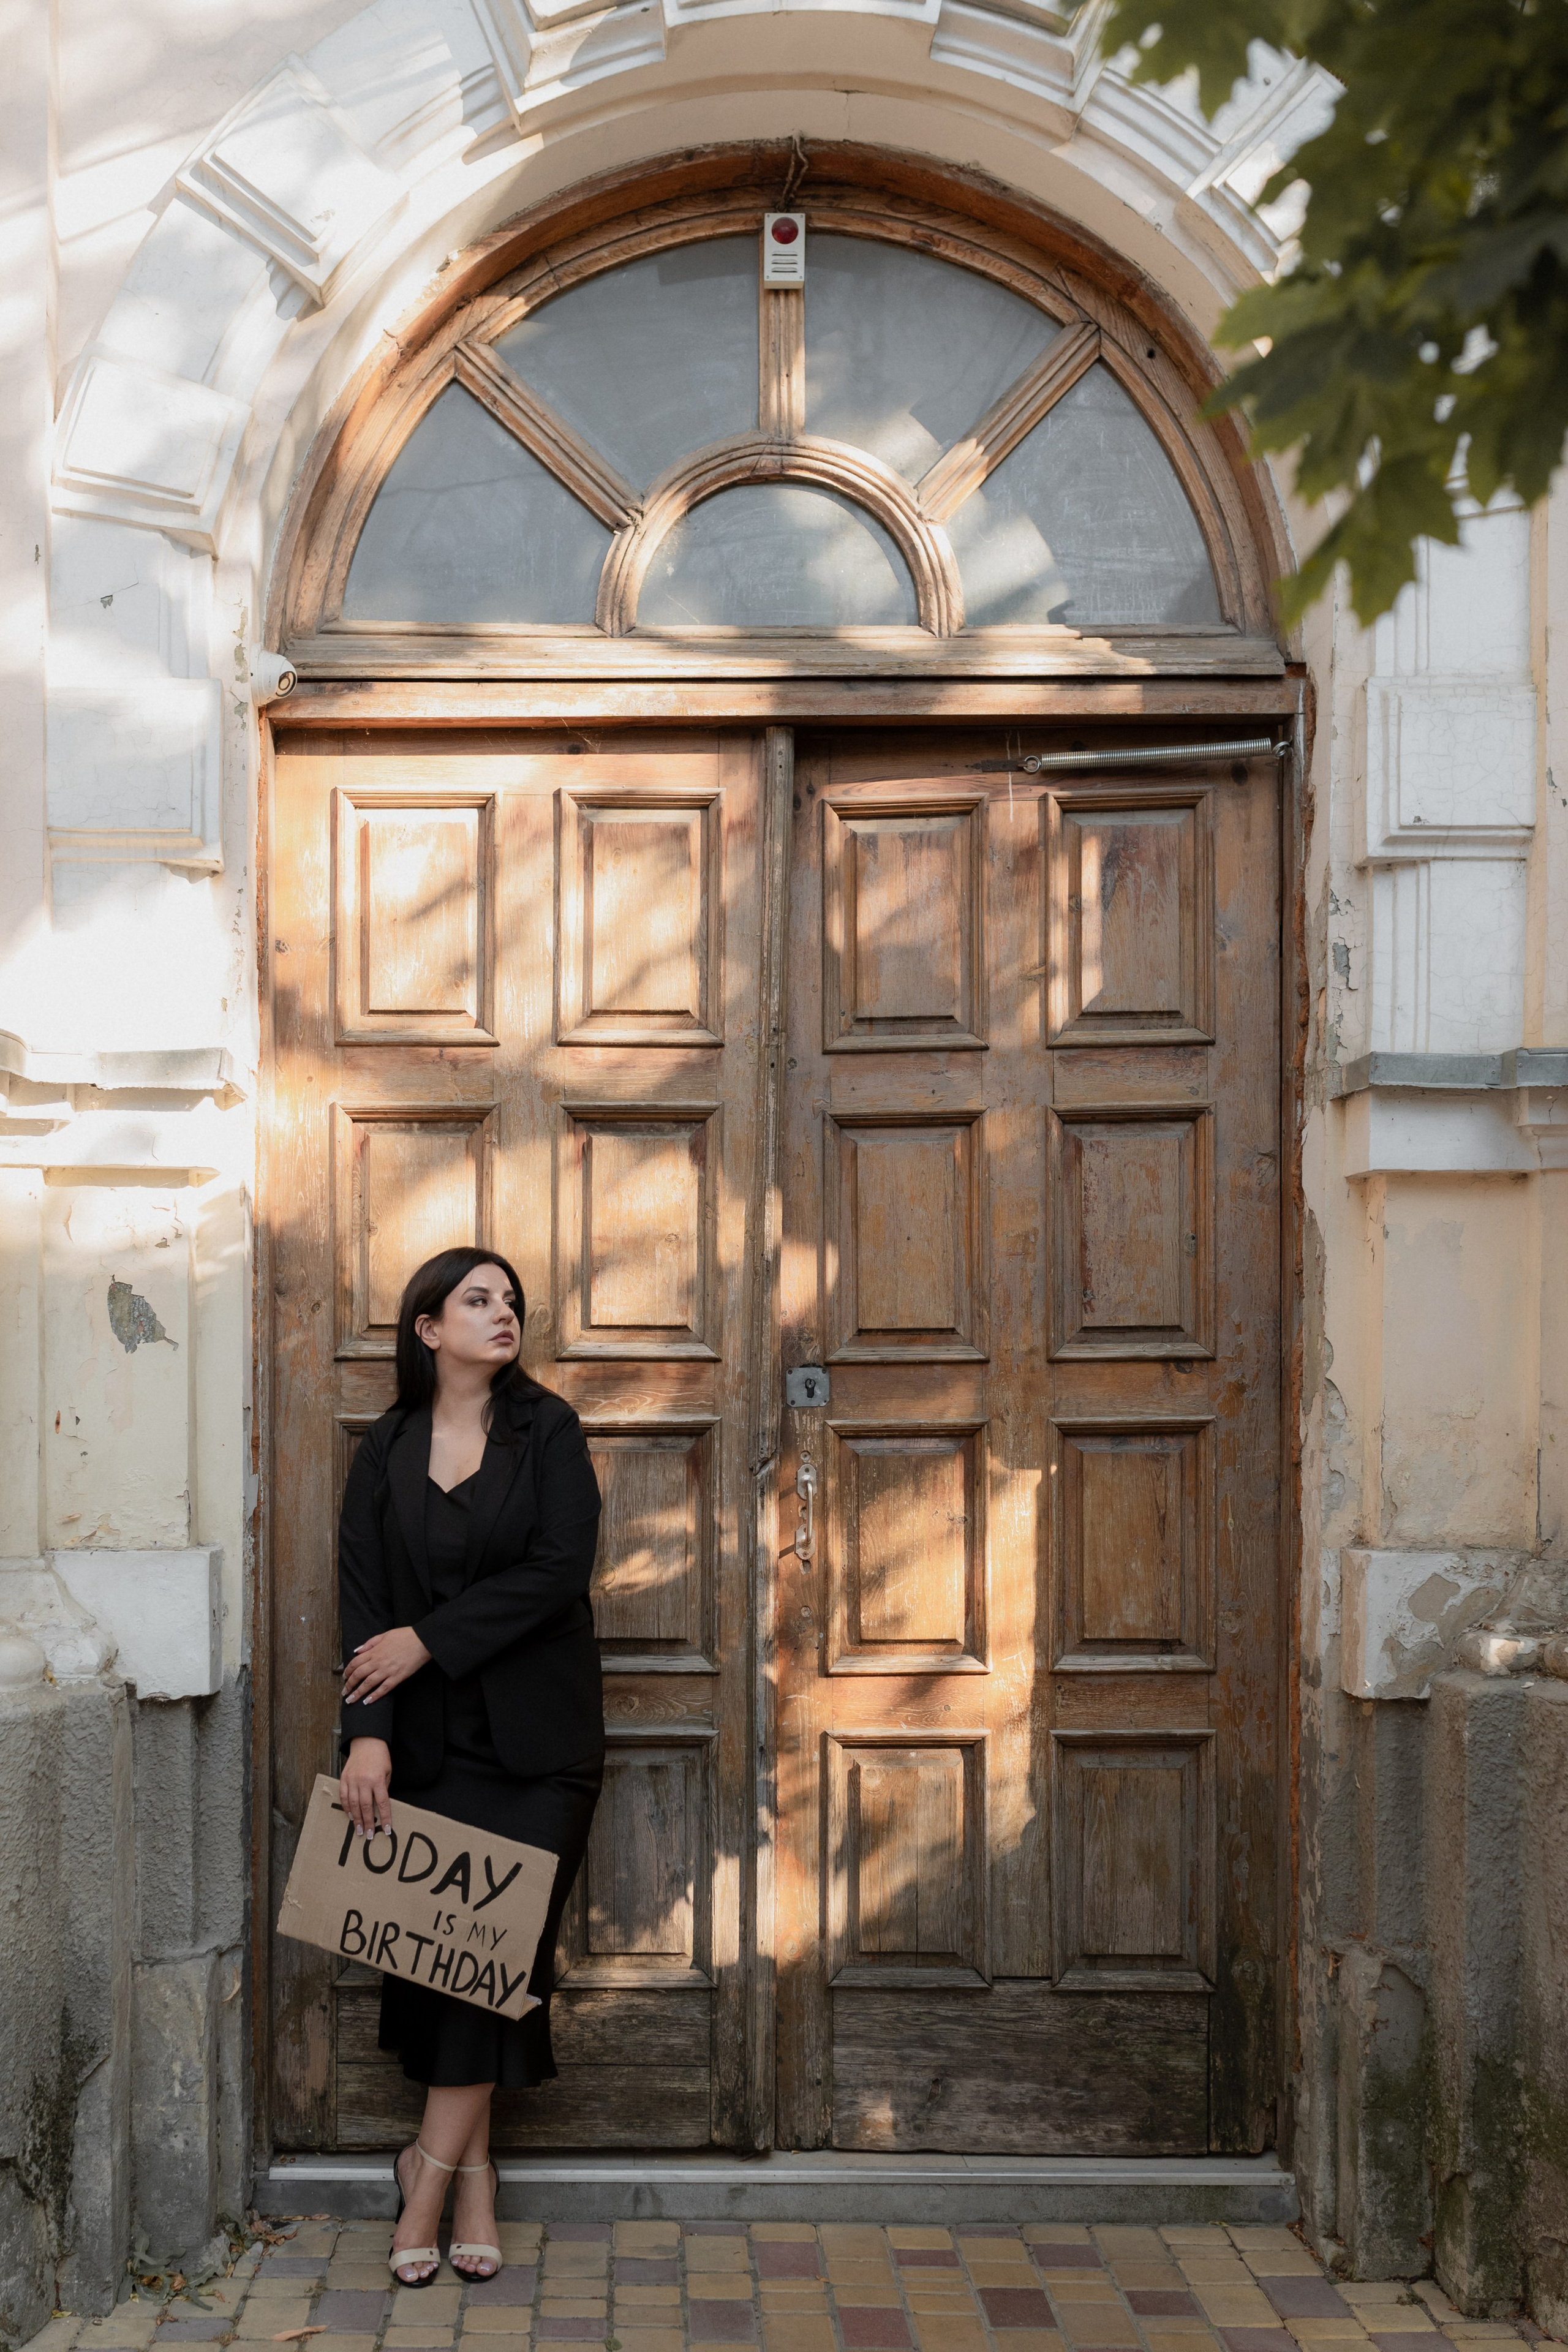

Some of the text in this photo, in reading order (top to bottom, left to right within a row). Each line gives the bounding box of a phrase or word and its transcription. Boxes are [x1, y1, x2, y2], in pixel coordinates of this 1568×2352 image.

[331, 1802, 523, 1912] TODAY
[340, 1909, 527, 2010] BIRTHDAY
[433, 1910, 508, 1951] IS MY
